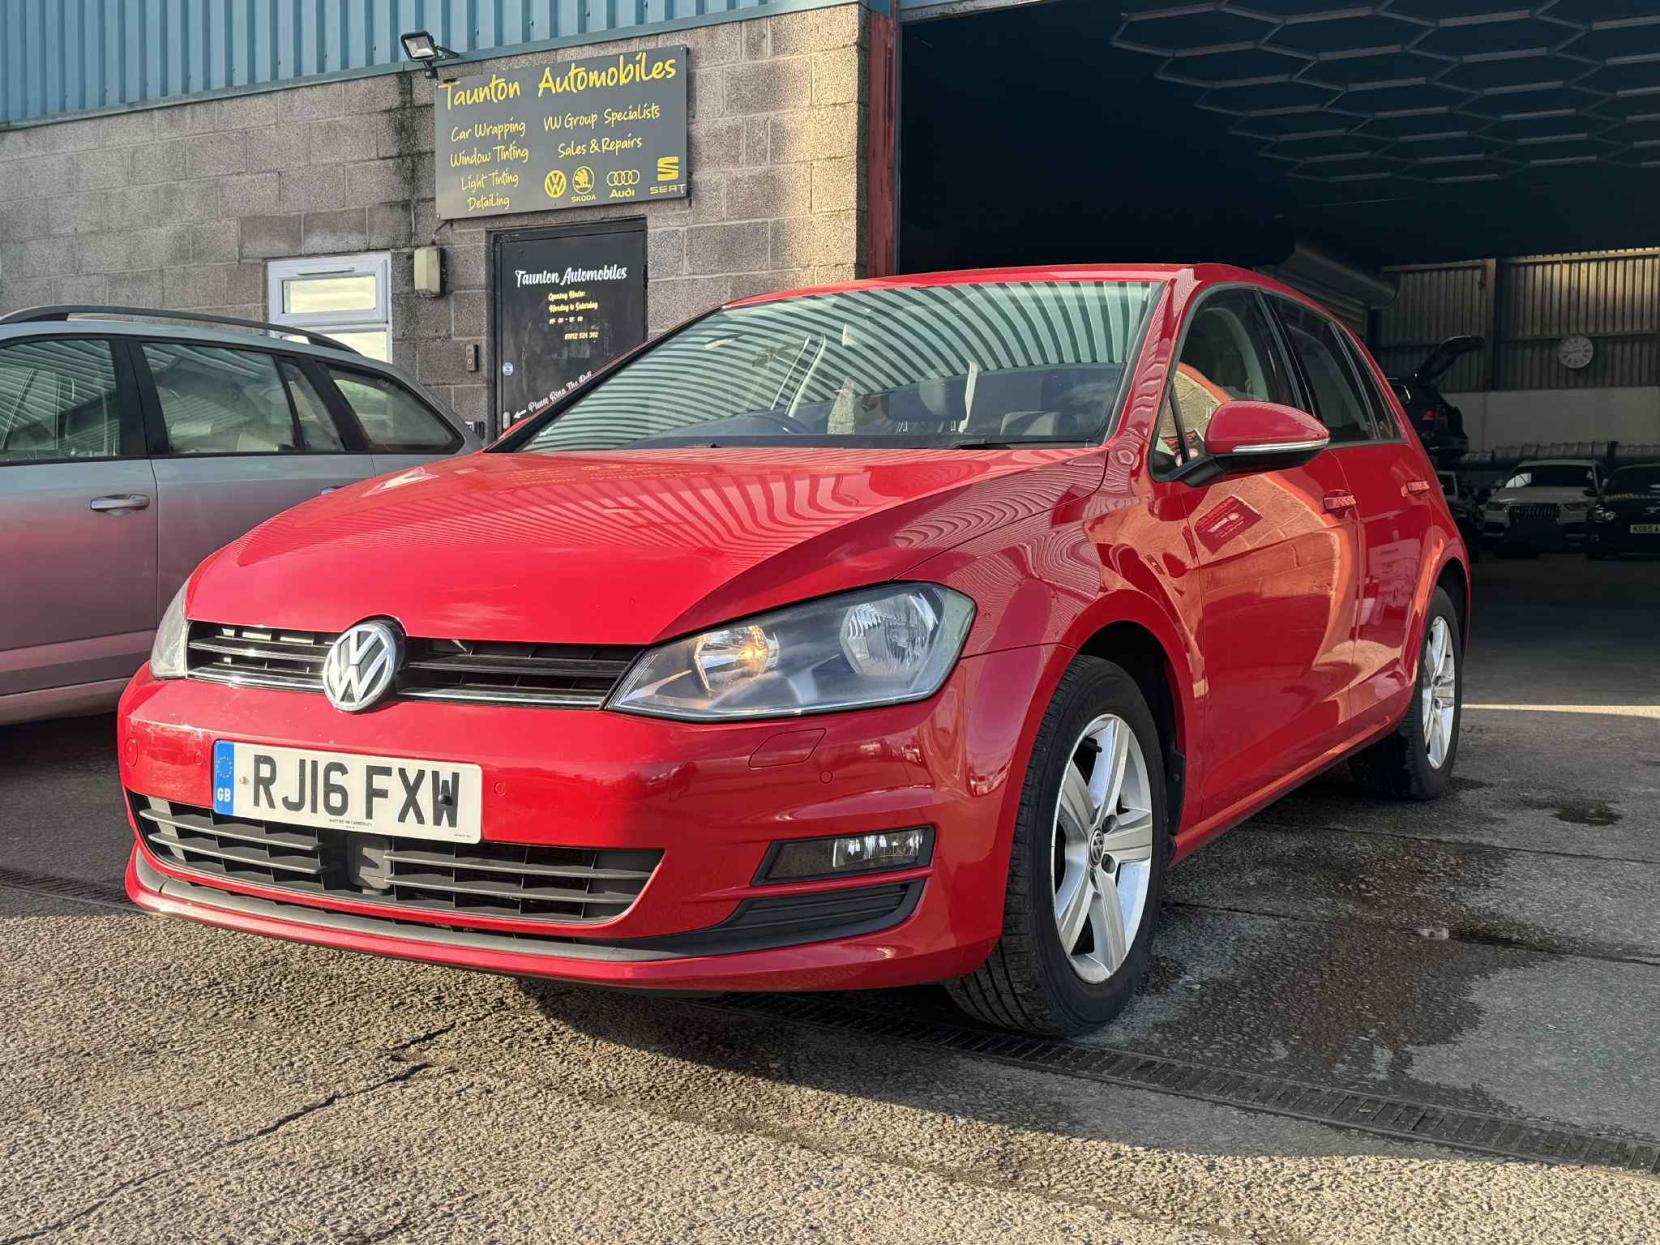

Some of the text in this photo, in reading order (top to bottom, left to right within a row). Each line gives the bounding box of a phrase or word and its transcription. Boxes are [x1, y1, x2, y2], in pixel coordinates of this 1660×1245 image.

[438, 49, 677, 111] Taunton Automobiles
[450, 116, 526, 143] Car Wrapping
[543, 102, 661, 132] VW Group Specialists
[450, 140, 529, 168] Window Tinting
[557, 133, 643, 159] Sales & Repairs
[460, 168, 519, 192] Light Tinting
[649, 184, 686, 195] SEAT
[467, 193, 510, 211] Detailing
[609, 188, 635, 199] Audi
[514, 264, 628, 288] Taunton Automobiles
[217, 787, 231, 803] GB
[253, 753, 461, 828] RJ16 FXW
